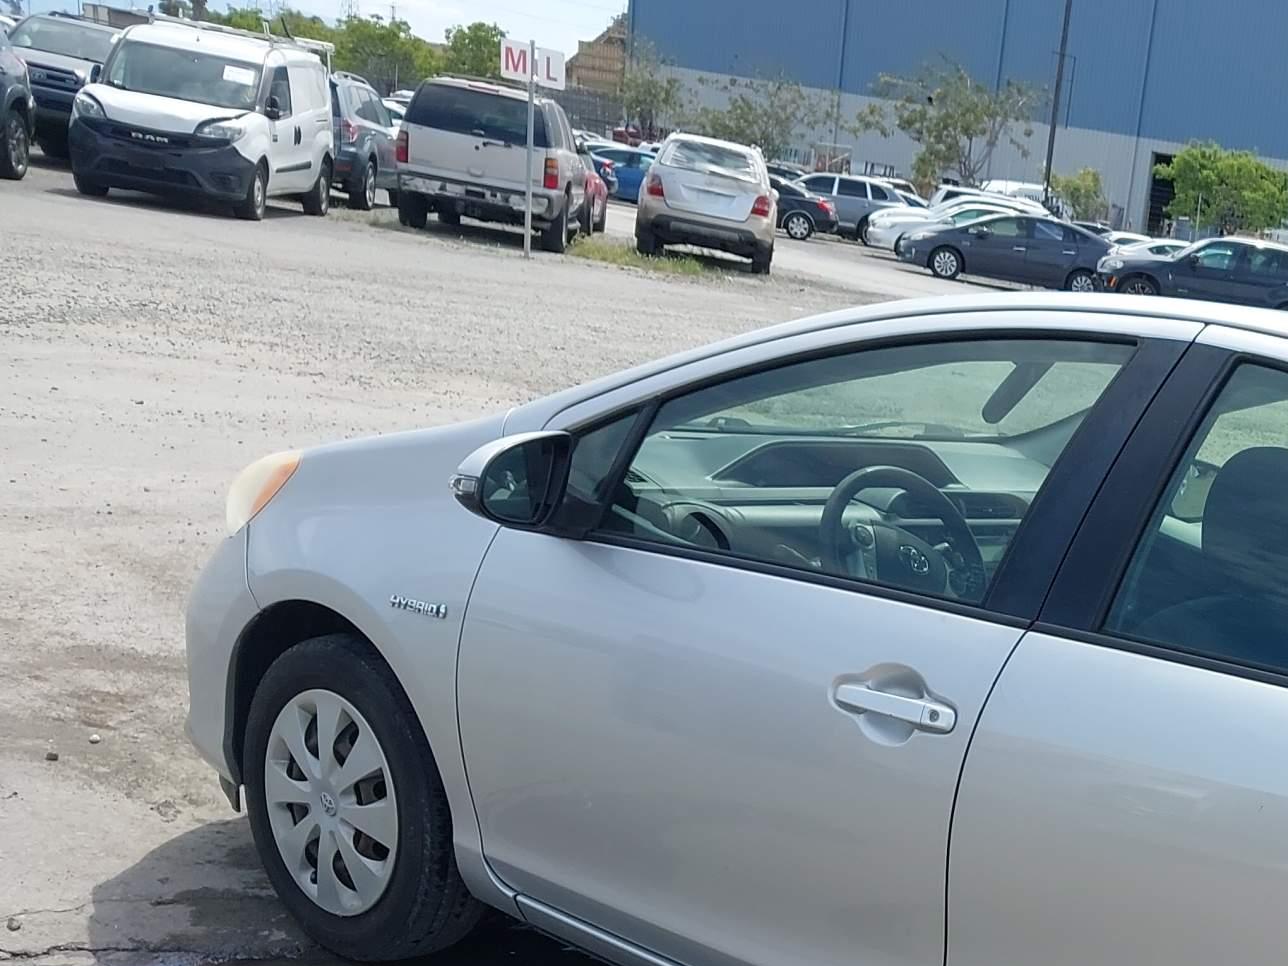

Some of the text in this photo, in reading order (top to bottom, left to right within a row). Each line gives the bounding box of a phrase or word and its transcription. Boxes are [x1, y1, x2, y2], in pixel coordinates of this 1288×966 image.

[505, 46, 527, 75] M
[545, 55, 558, 82] L
[131, 131, 169, 144] RAM
[389, 594, 440, 618] HYBRID
